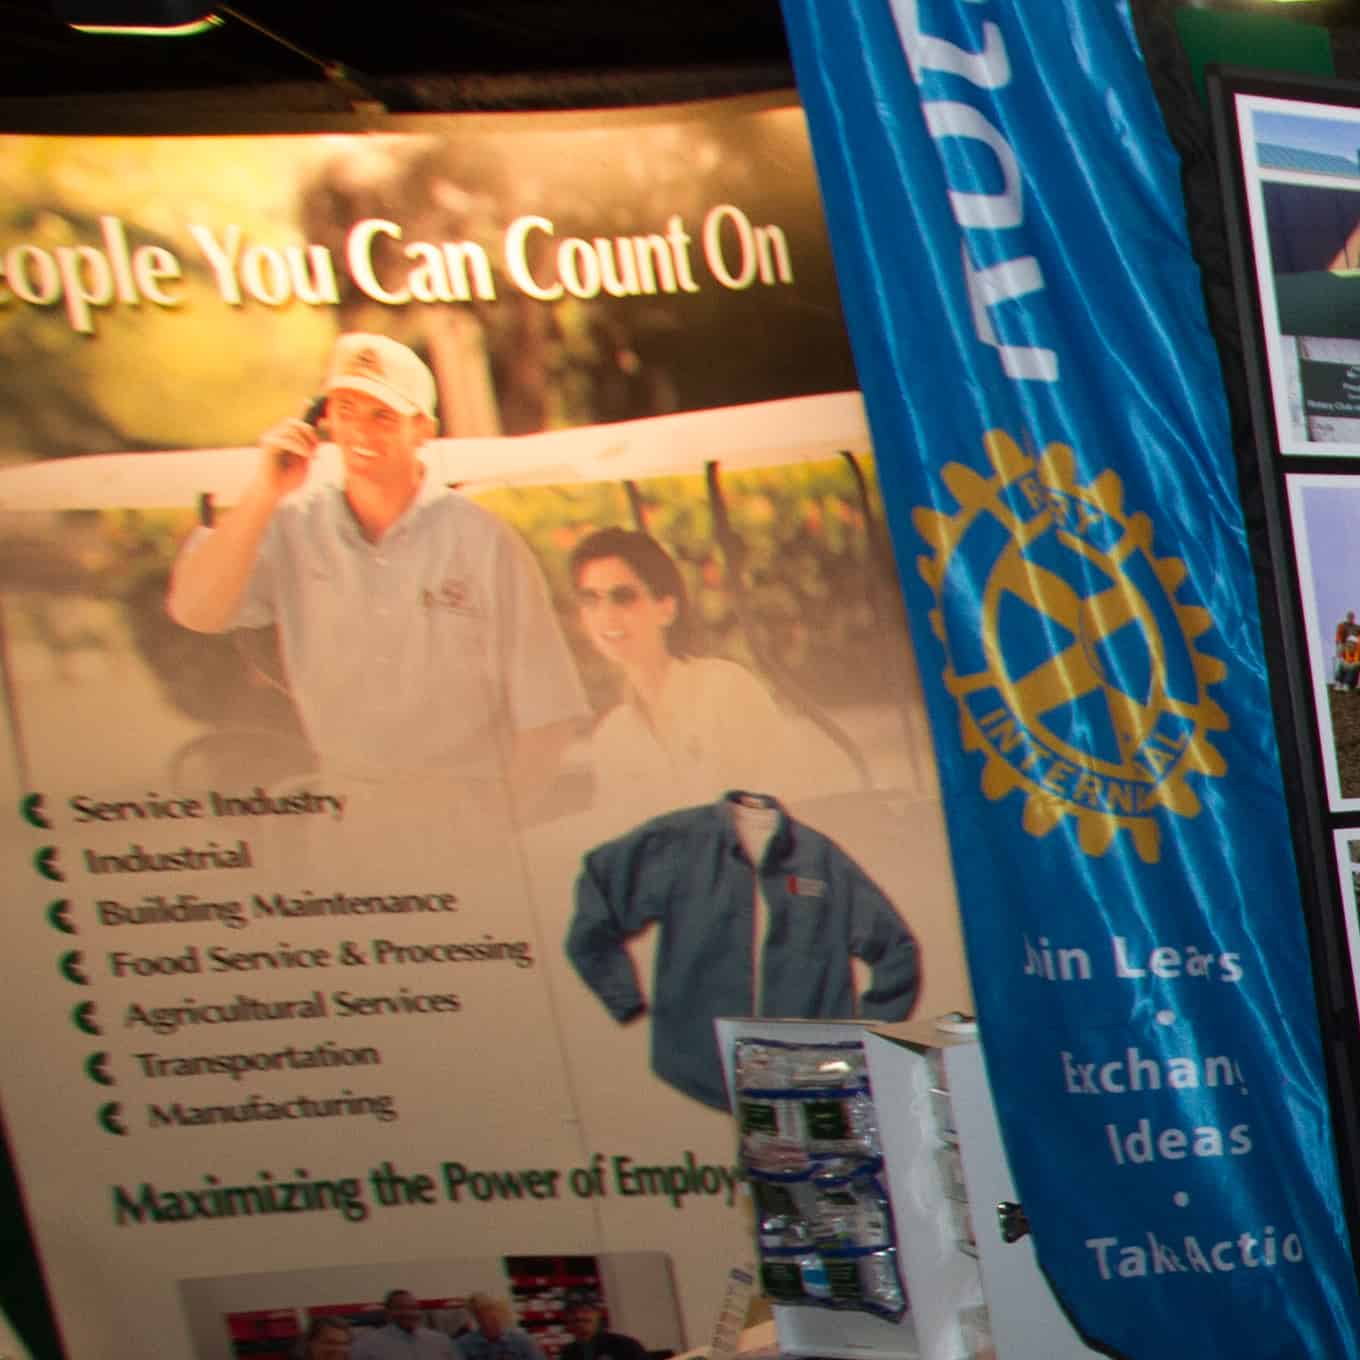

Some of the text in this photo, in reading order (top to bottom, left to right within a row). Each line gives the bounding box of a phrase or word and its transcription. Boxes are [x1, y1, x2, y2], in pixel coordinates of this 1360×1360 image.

[0, 204, 793, 333] ople You Can Count On
[71, 788, 347, 823] Service Industry
[84, 841, 254, 875] Industrial
[100, 889, 457, 928] Building Maintenance
[112, 935, 536, 977] Food Service & Processing
[125, 987, 461, 1034] Agricultural Services
[133, 1041, 381, 1080] Transportation
[149, 1089, 398, 1129] Manufacturing
[1106, 1118, 1252, 1166] Ideas
[113, 1150, 746, 1228] Maximizing the Power of Employ
[1184, 1225, 1304, 1273] Actio
